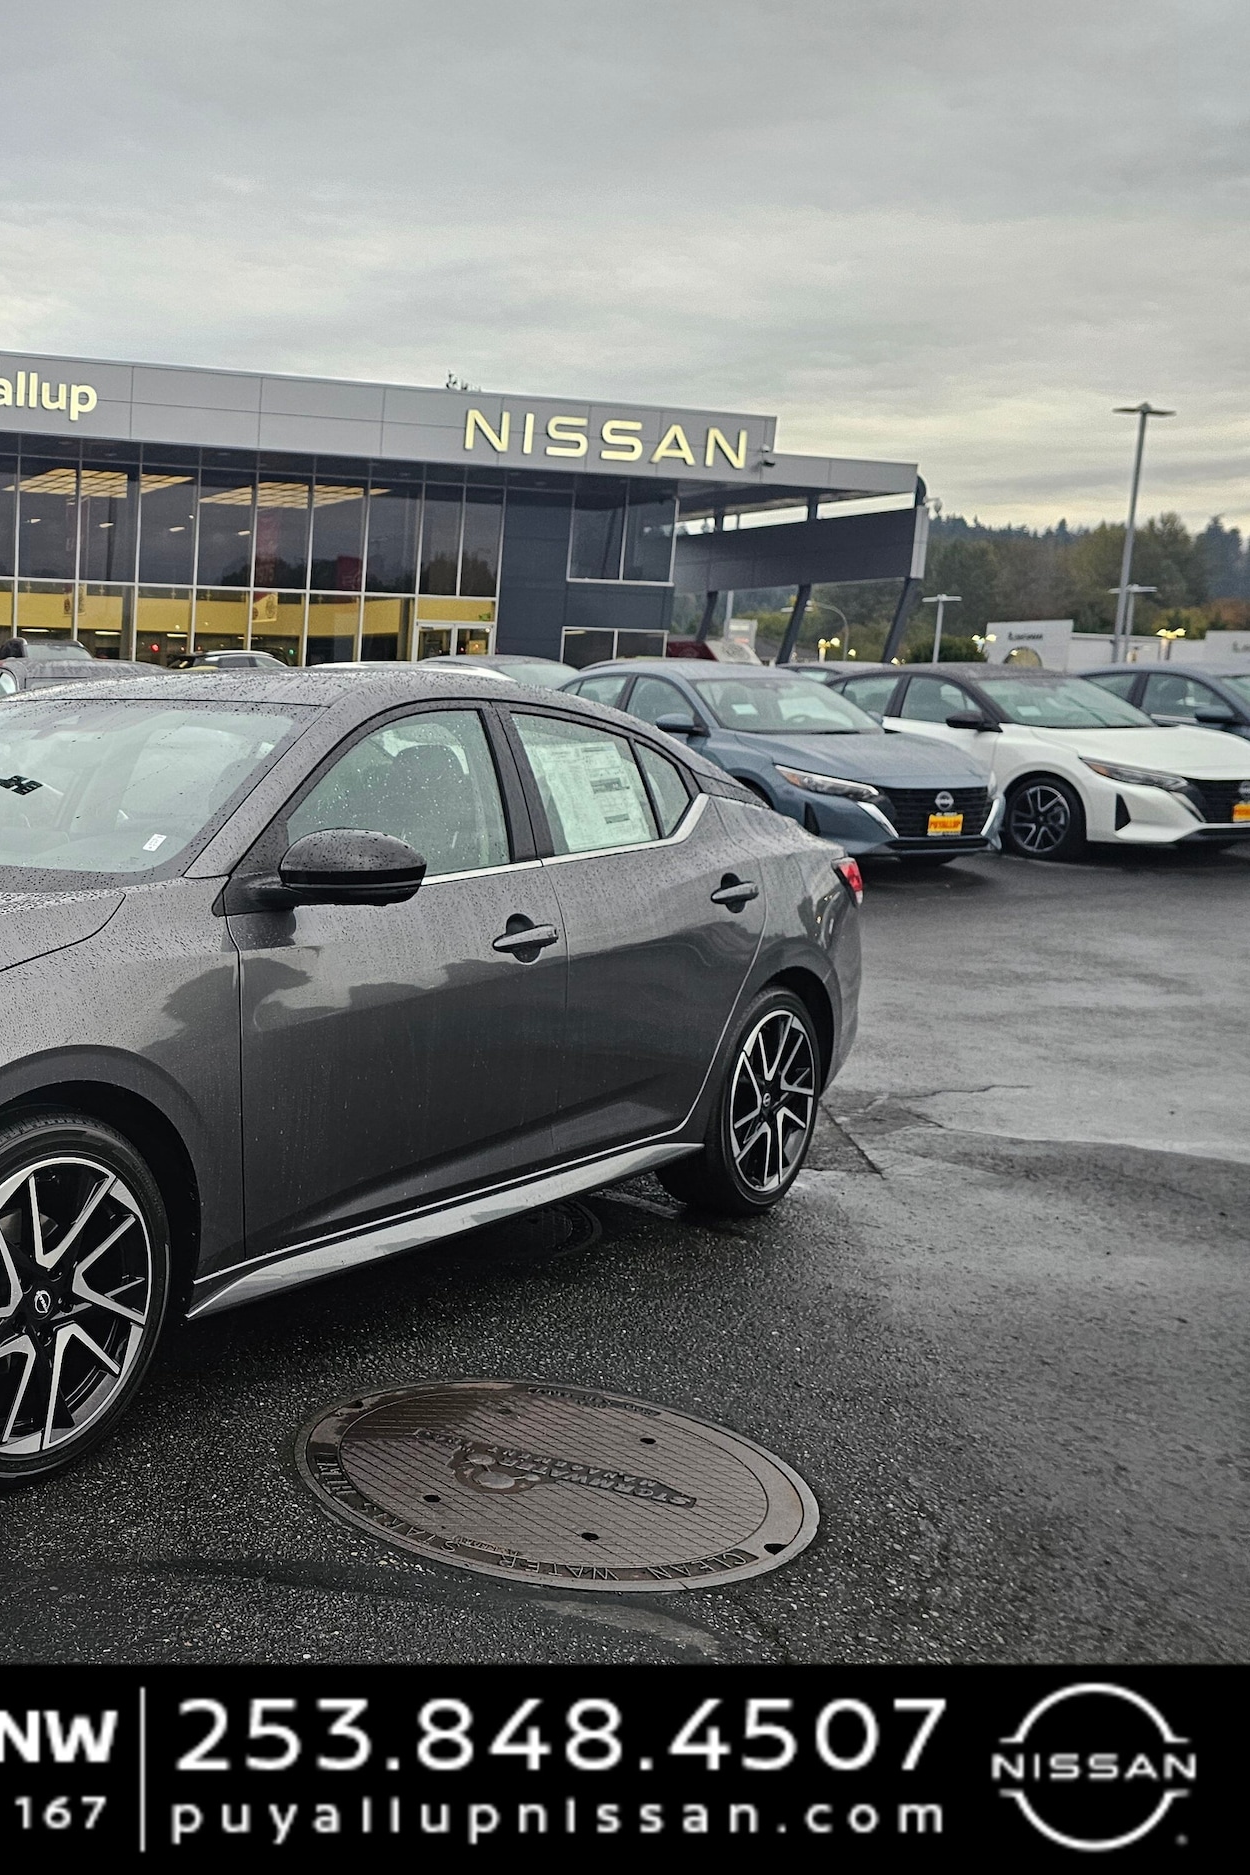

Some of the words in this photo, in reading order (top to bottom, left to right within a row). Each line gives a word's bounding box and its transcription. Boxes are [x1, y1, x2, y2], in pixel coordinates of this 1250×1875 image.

[464, 408, 748, 470] NISSAN
[499, 1550, 620, 1581] WATER
[646, 1551, 748, 1581] CLEAN
